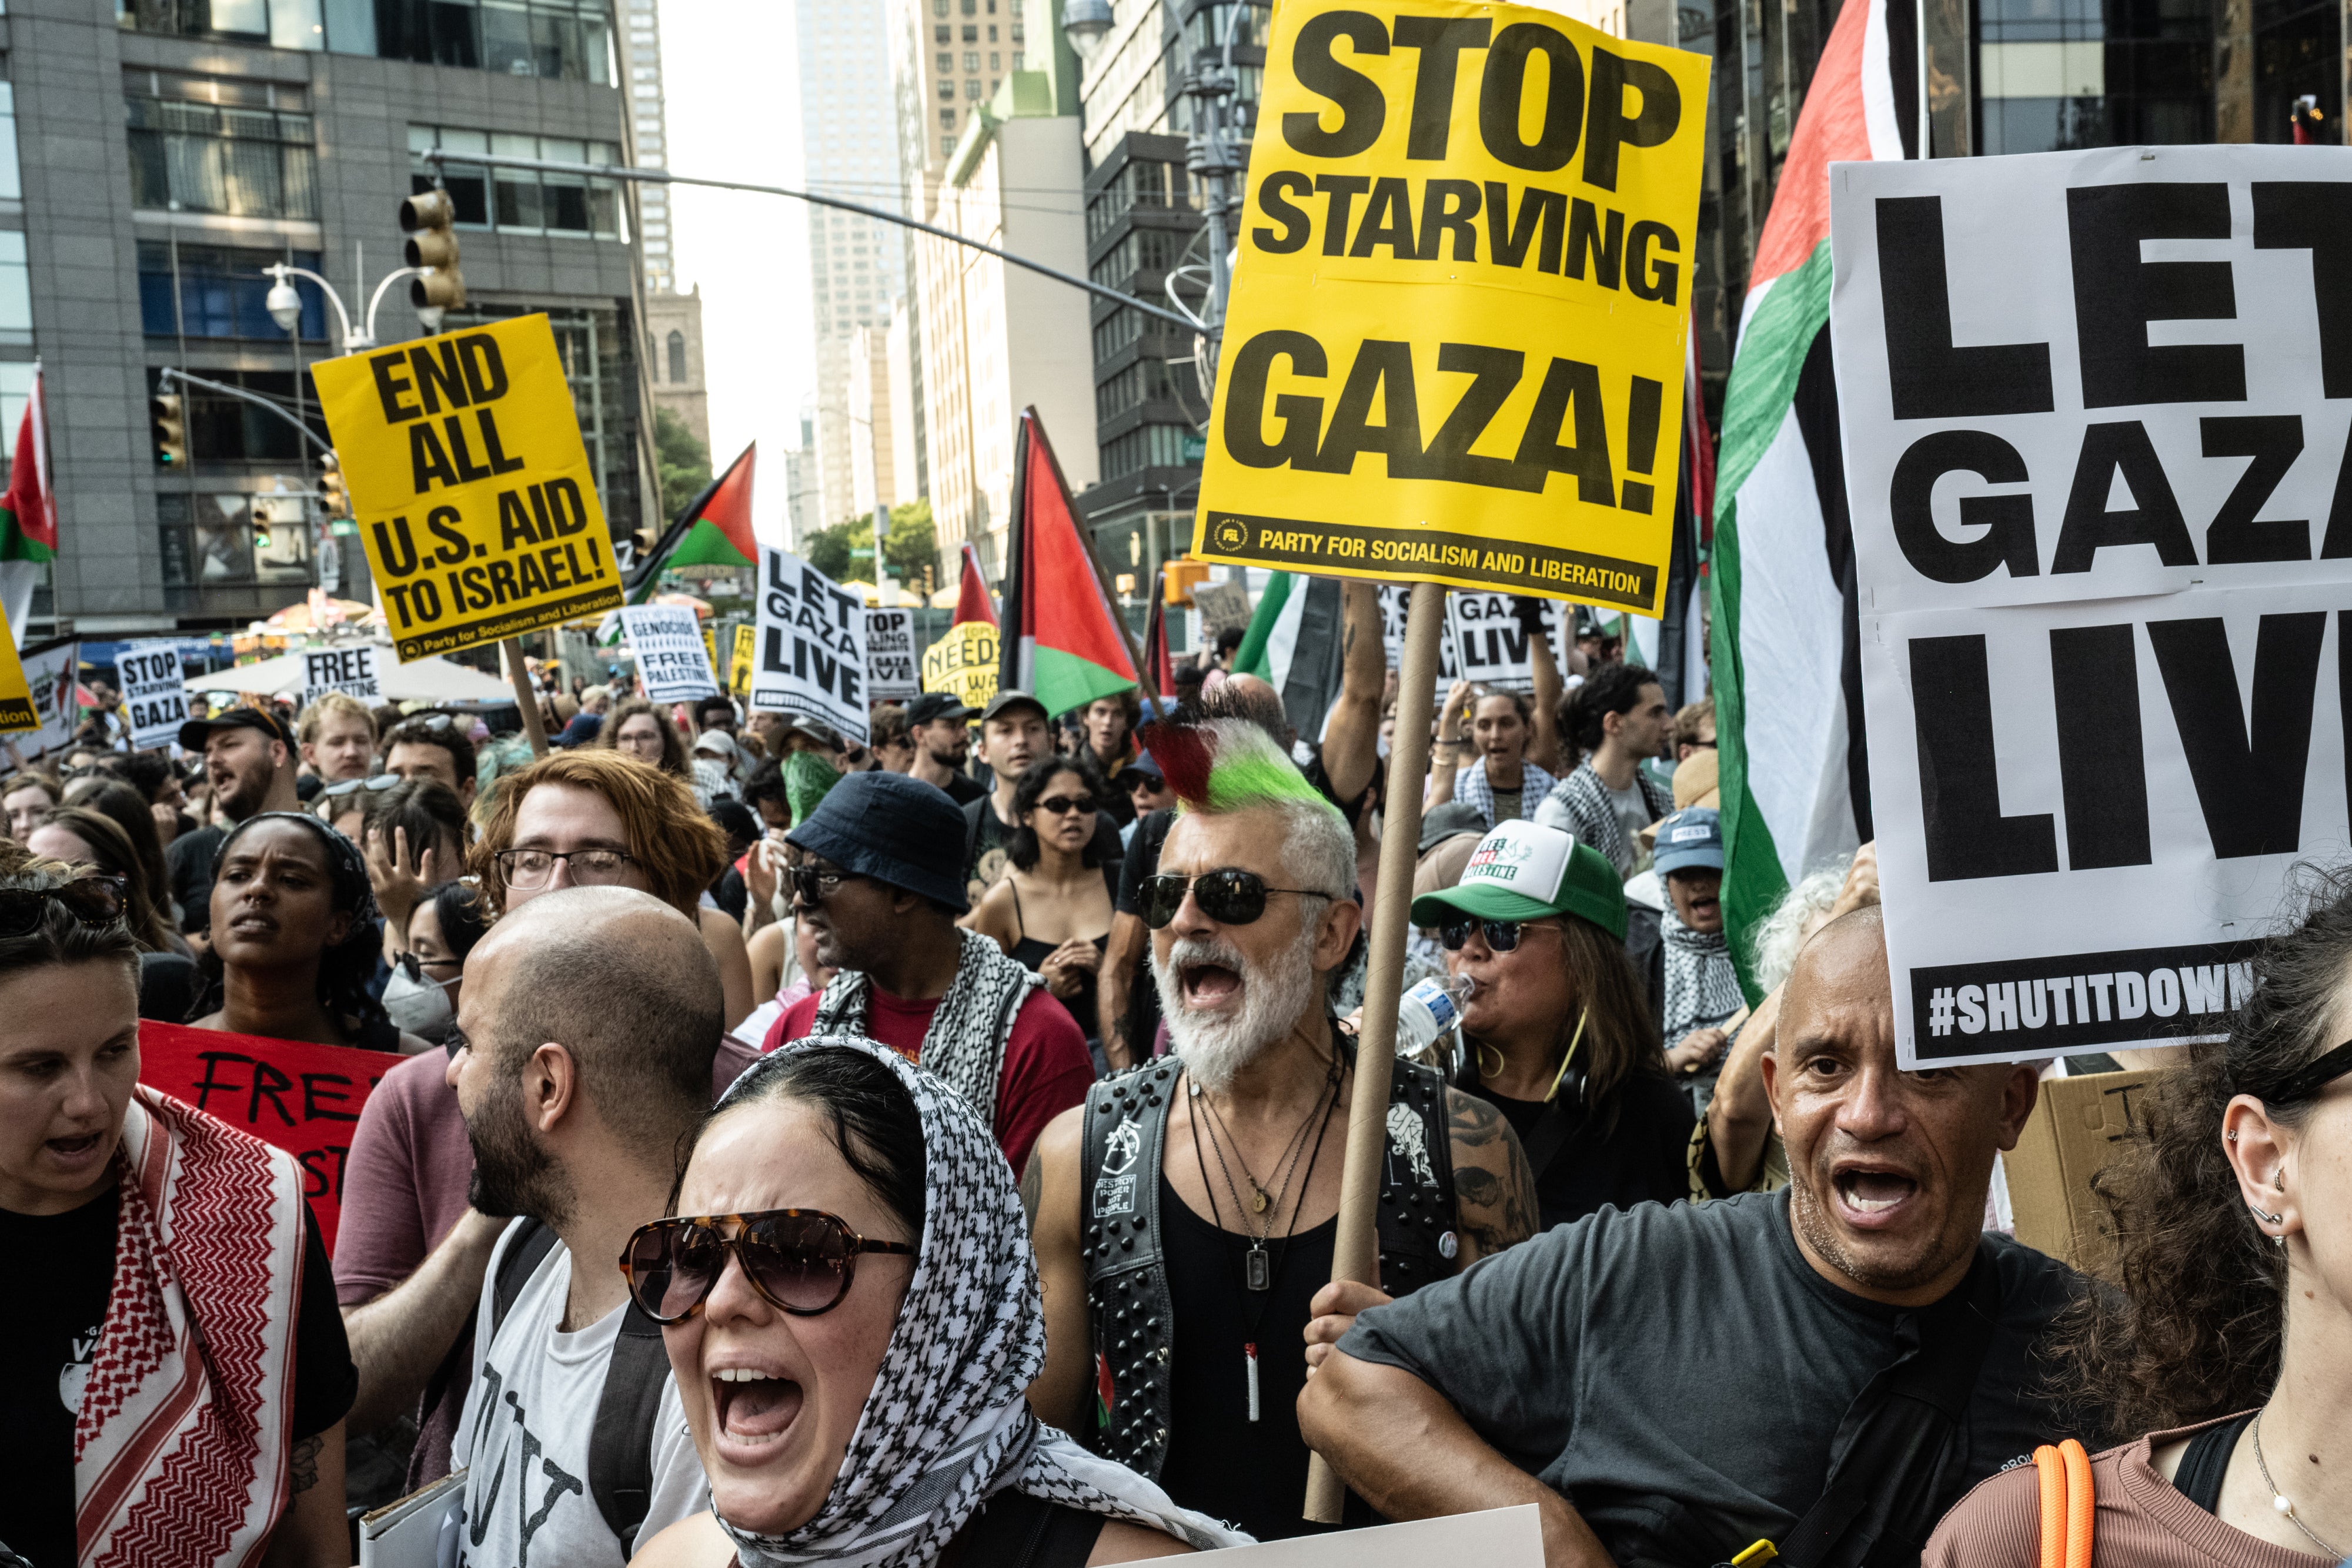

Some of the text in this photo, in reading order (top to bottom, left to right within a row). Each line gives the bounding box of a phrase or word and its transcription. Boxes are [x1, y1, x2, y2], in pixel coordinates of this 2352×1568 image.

[1281, 11, 1682, 193] STOP
[1252, 170, 1681, 307] STARVING
[1875, 181, 2352, 420] LET
[369, 332, 510, 424] END
[408, 407, 526, 495] ALL
[1222, 329, 1663, 516] GAZA!
[371, 477, 589, 580] U.S. AID
[1890, 414, 2352, 584] GAZ
[386, 536, 606, 629] TO ISRAEL!
[769, 550, 860, 630] LET
[1259, 529, 1642, 595] PARTY FOR SOCIALISM AND LIBERATION
[423, 636, 456, 652] Party
[459, 630, 477, 643] for
[477, 616, 536, 638] Socialism
[537, 609, 562, 624] and
[563, 593, 621, 616] Liberation
[766, 591, 860, 663] GAZA
[1459, 596, 1554, 621] GAA
[123, 651, 176, 684] STOP
[307, 647, 373, 685] FREE
[643, 652, 704, 667] FREE
[763, 625, 863, 712] LIVE
[132, 697, 185, 729] GAZA
[1907, 610, 2352, 882] LIV
[191, 1051, 382, 1126] FRE
[1095, 1176, 1135, 1189] DESTROY
[1097, 1201, 1129, 1216] PEOPLE
